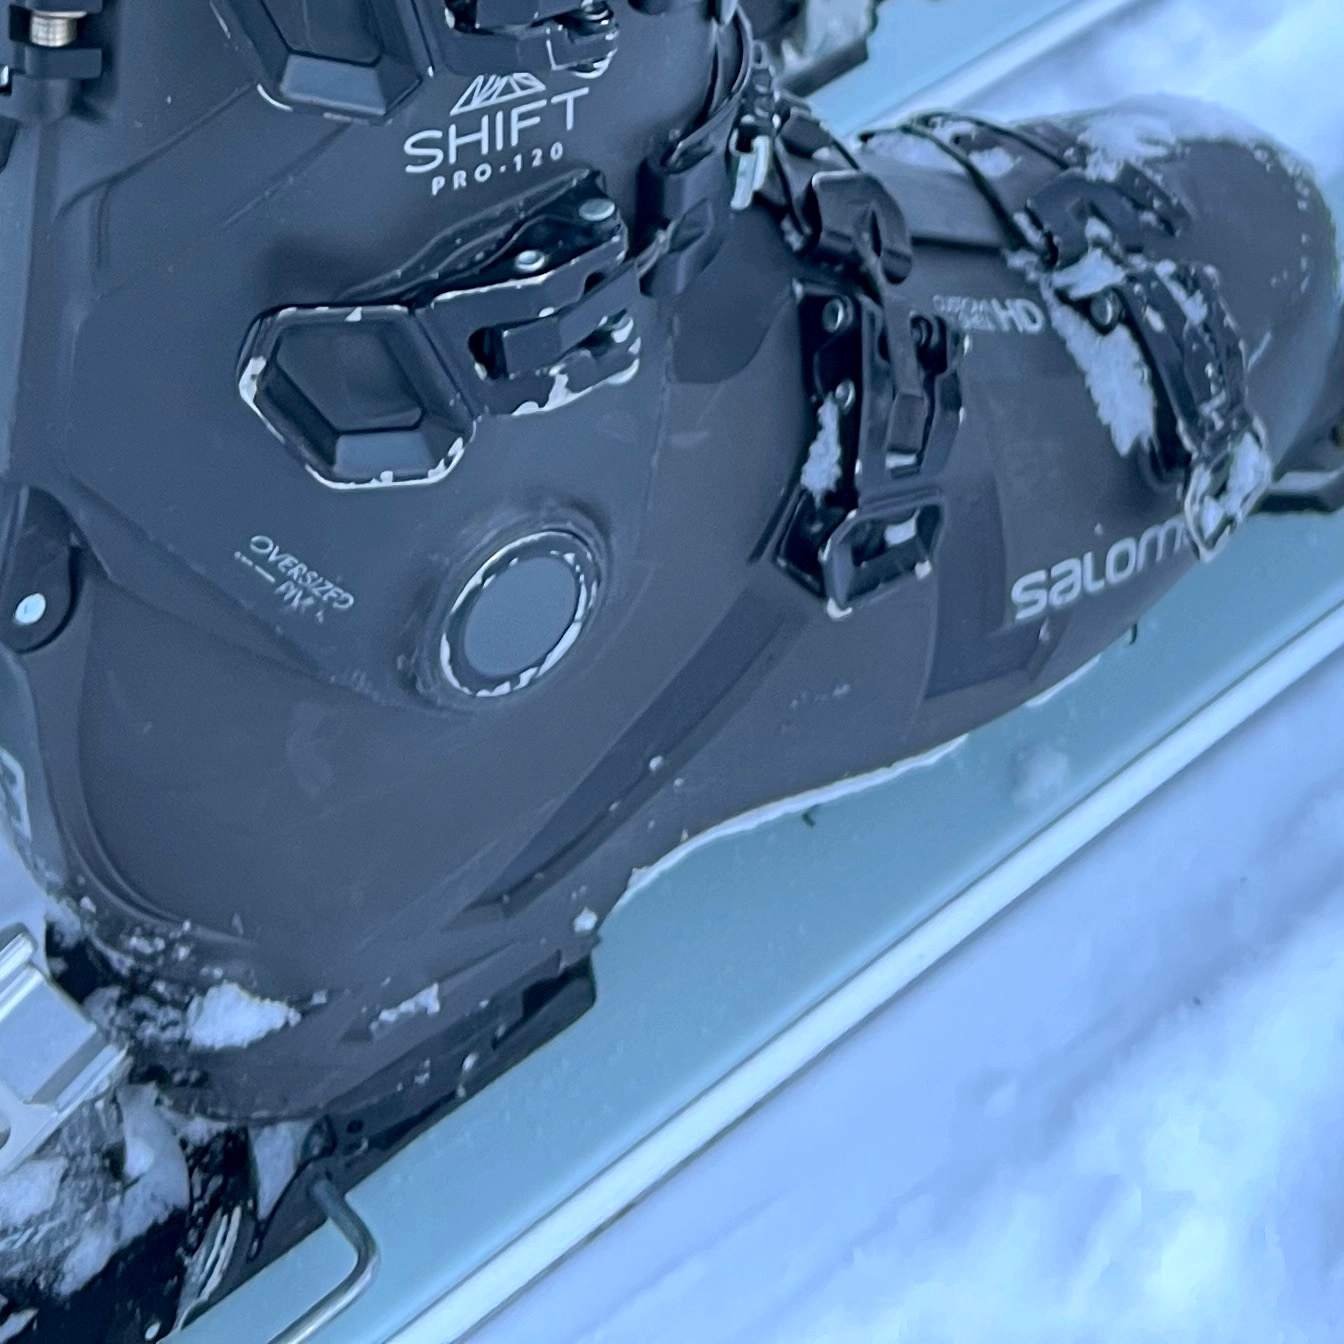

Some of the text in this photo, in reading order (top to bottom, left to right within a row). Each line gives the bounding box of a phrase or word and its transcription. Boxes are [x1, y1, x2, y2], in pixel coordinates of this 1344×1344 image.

[404, 86, 590, 174] SHIFT
[990, 296, 1046, 335] HD
[250, 535, 355, 611] OVERSIZED
